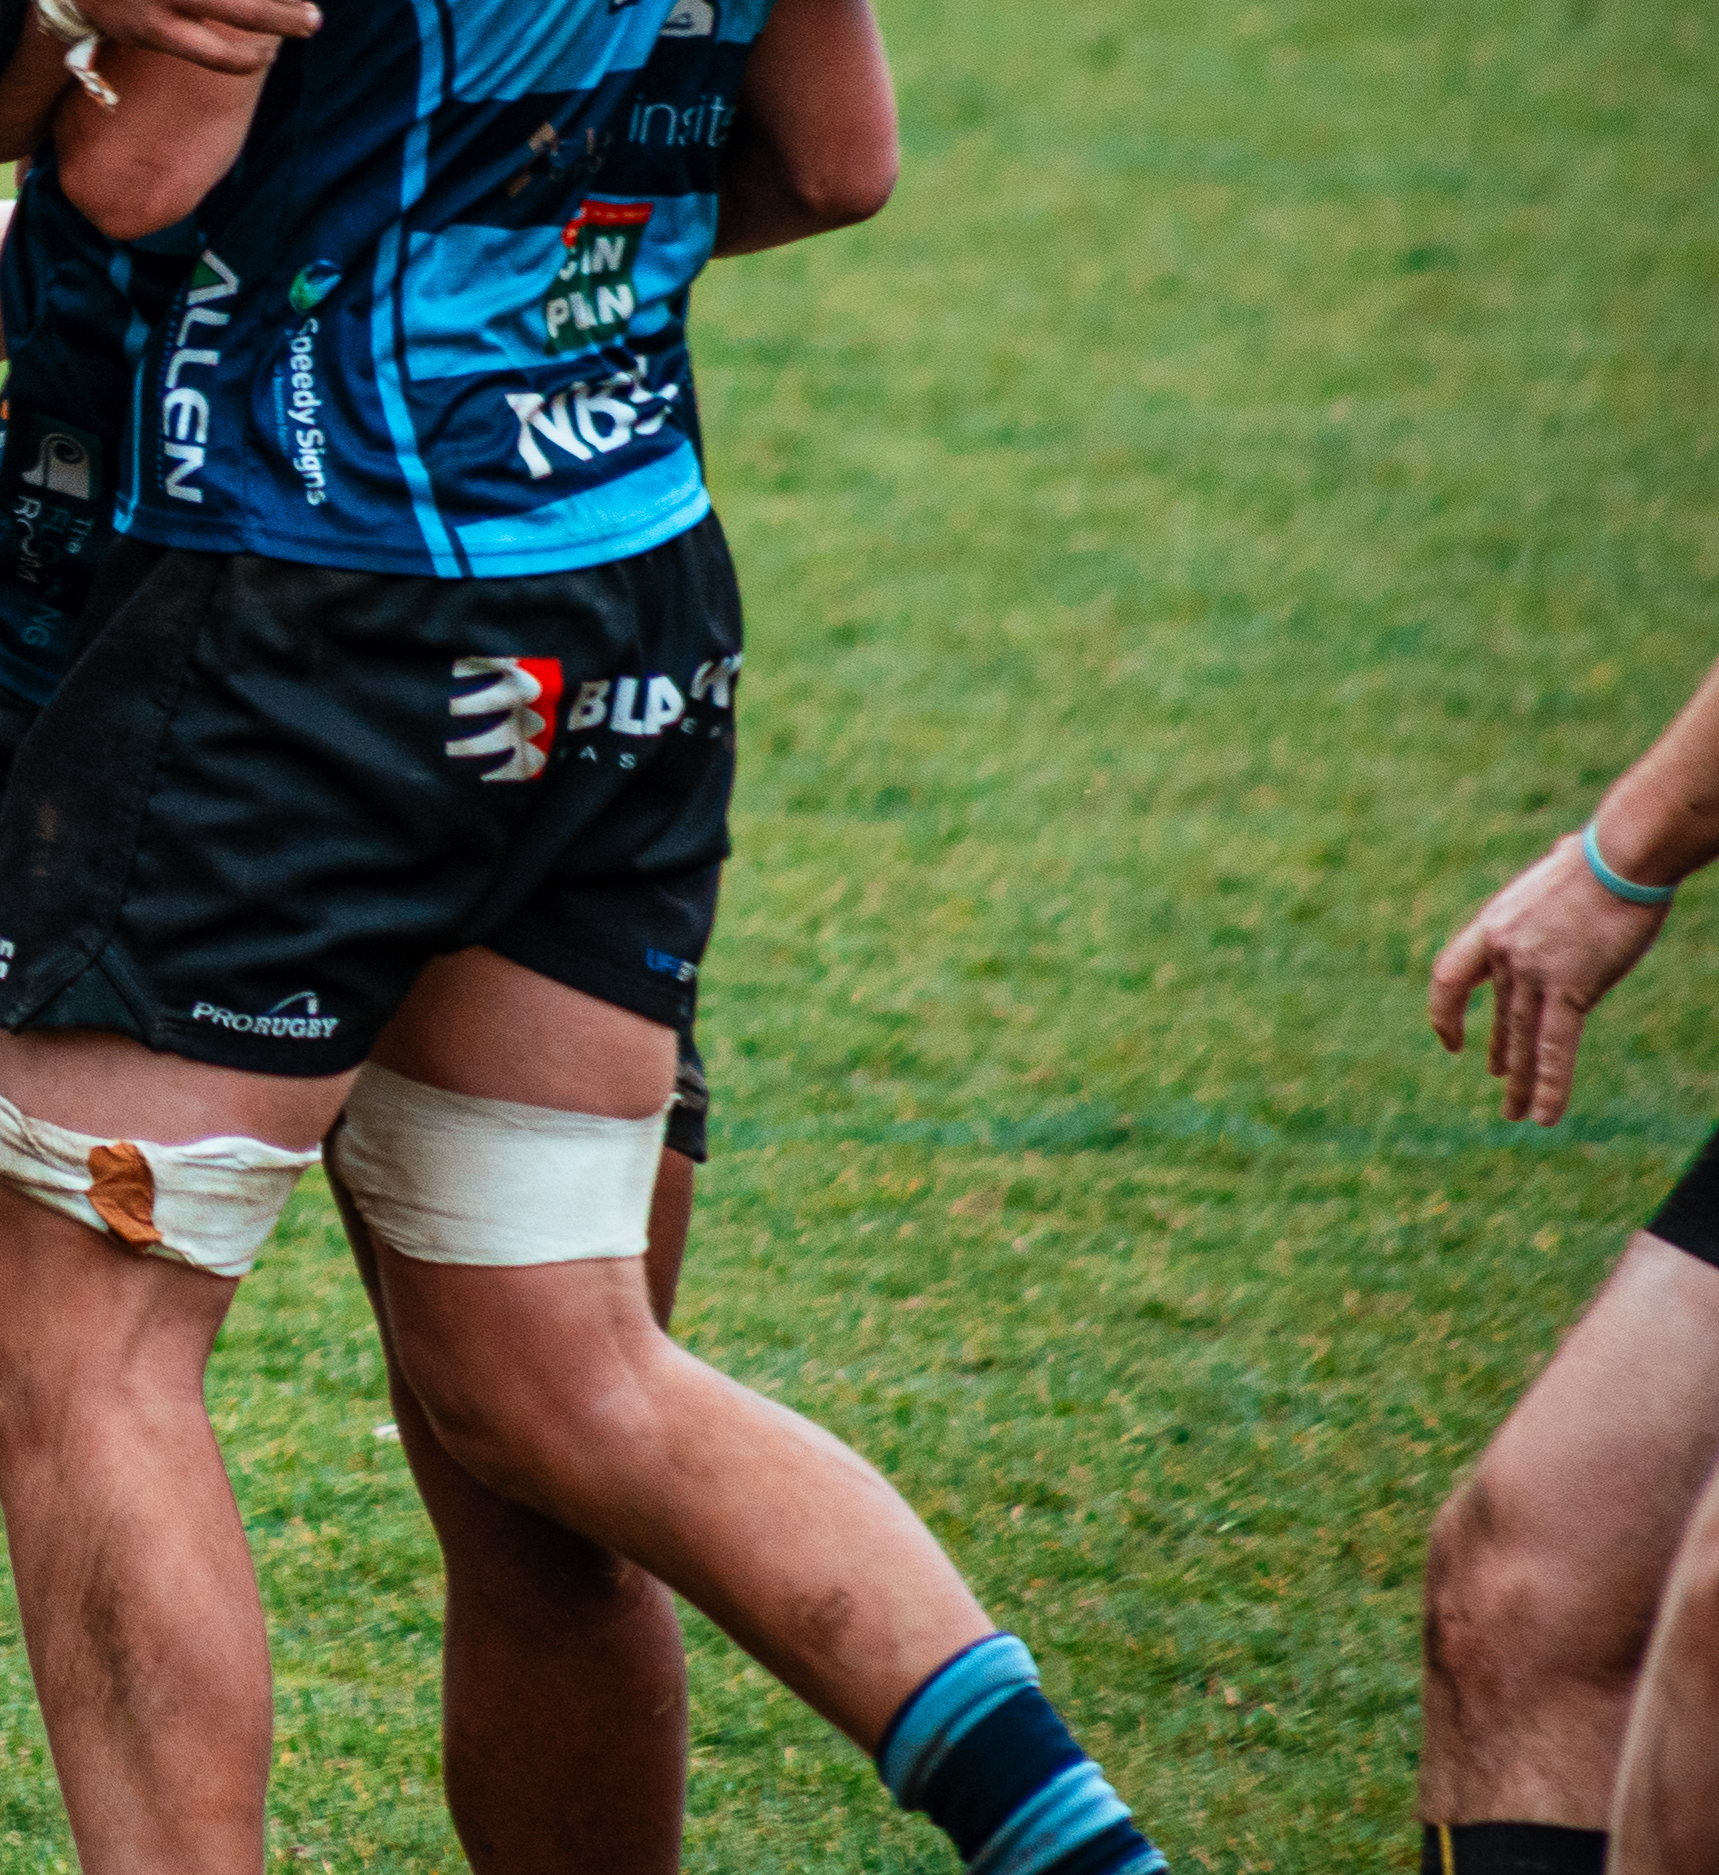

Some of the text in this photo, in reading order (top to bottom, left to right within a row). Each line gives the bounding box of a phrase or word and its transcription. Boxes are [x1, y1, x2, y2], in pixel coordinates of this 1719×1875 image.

[163, 248, 240, 504] ALLEN
[292, 428, 328, 506] Signs
[191, 1000, 341, 1039] PRORUGBY
